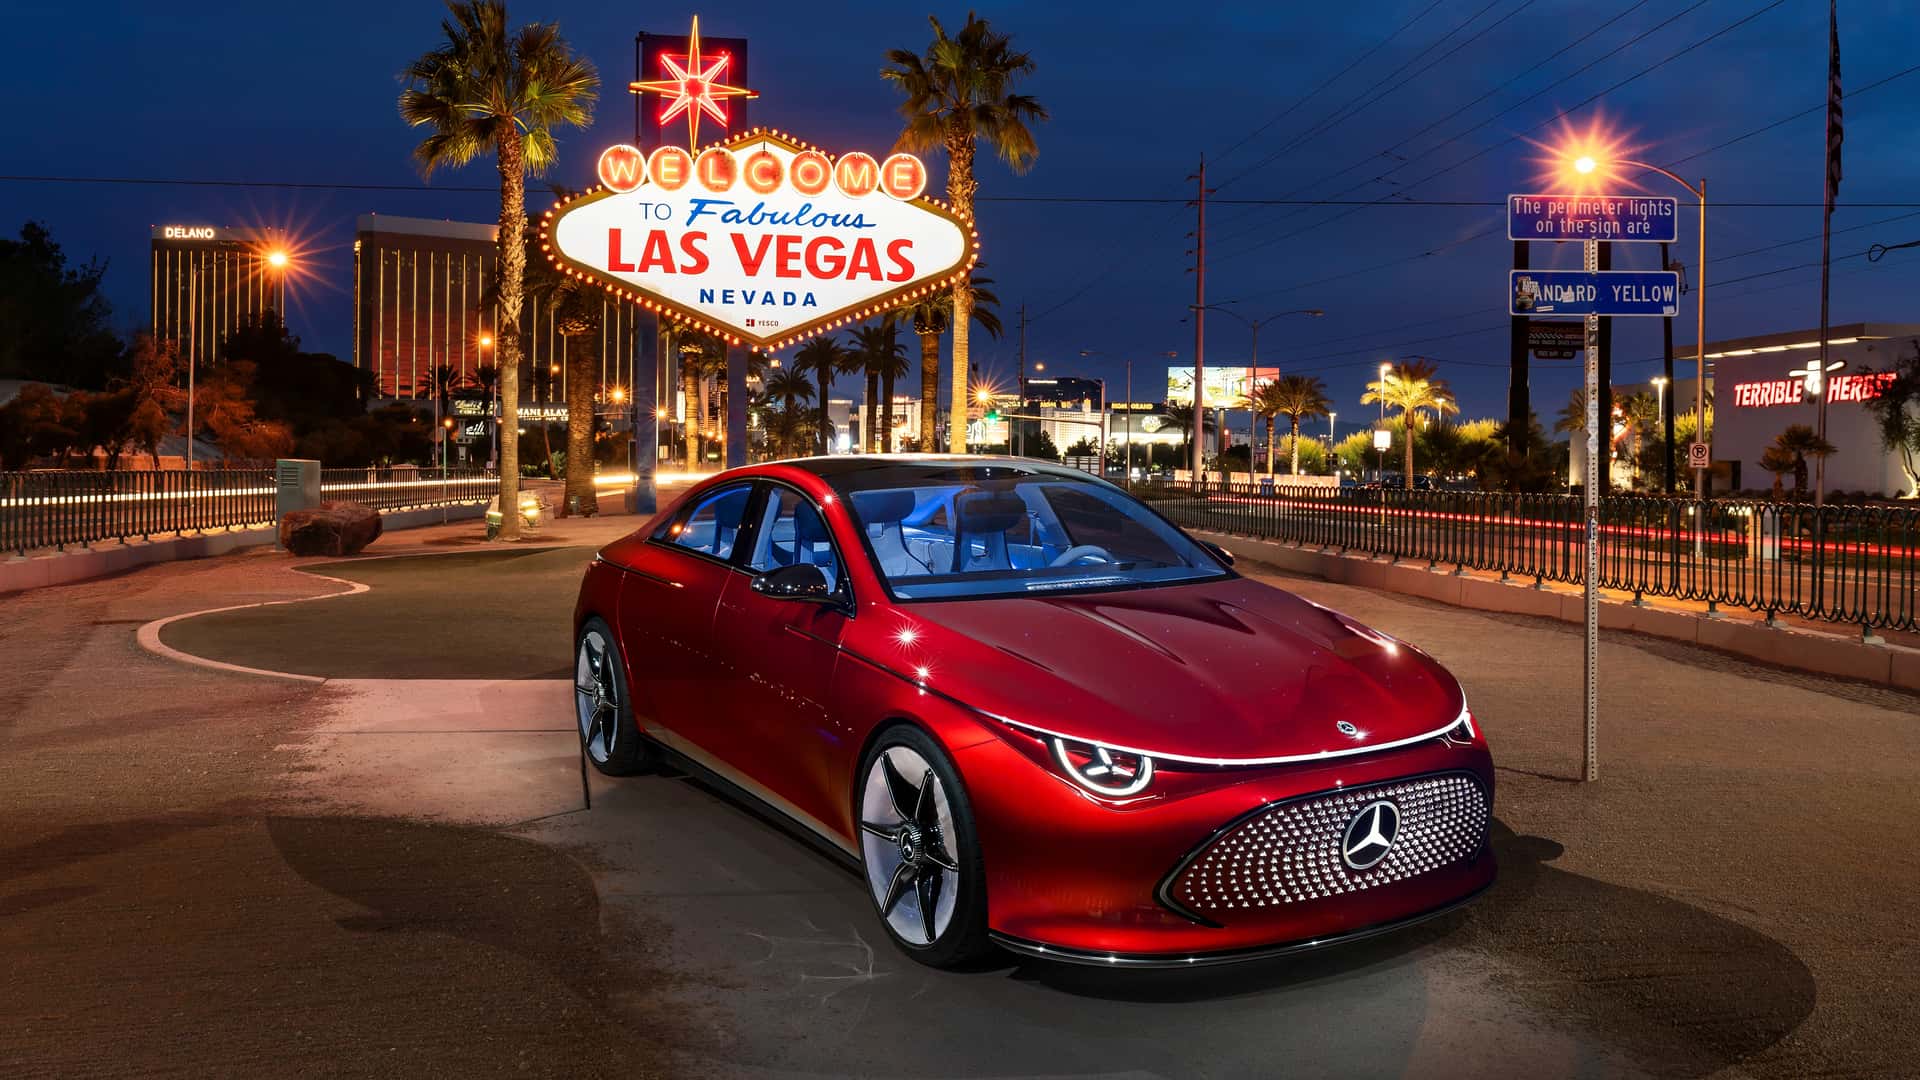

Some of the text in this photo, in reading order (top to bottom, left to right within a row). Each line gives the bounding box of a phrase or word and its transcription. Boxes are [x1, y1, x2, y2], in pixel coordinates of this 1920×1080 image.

[607, 154, 913, 191] WELCOME
[639, 198, 877, 229] TO Fabulous
[1514, 197, 1672, 221] The perimeter lights
[165, 226, 215, 239] DELANO
[1536, 218, 1650, 238] on the sign are
[608, 228, 915, 282] LAS VEGAS
[699, 288, 817, 307] NEVADA
[1516, 284, 1674, 302] ANDARD YELLOW
[1734, 379, 1803, 407] TERRIBLE
